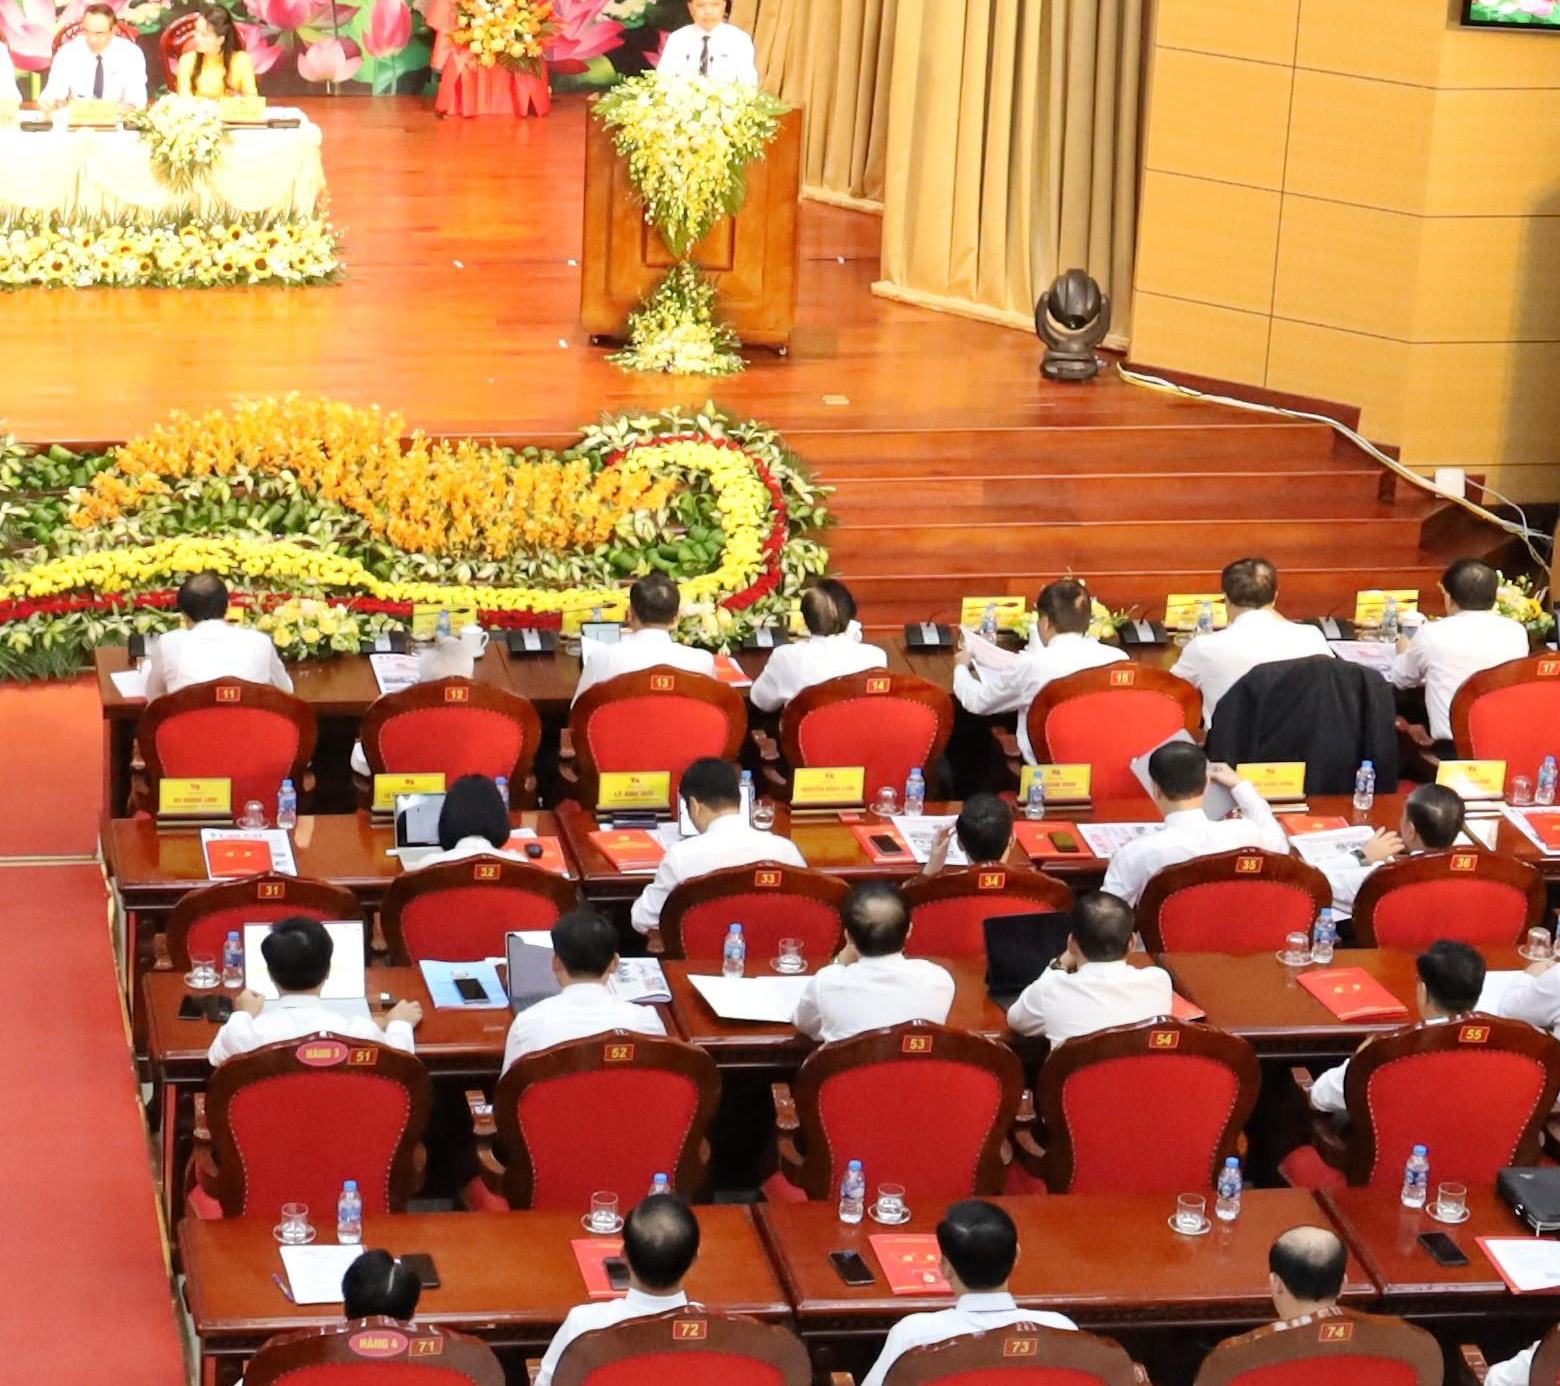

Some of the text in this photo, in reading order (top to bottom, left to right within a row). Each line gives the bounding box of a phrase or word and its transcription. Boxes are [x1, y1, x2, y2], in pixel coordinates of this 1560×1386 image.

[1465, 1028, 1483, 1041] 55
[356, 1050, 371, 1063] 51
[681, 1322, 700, 1337] 72
